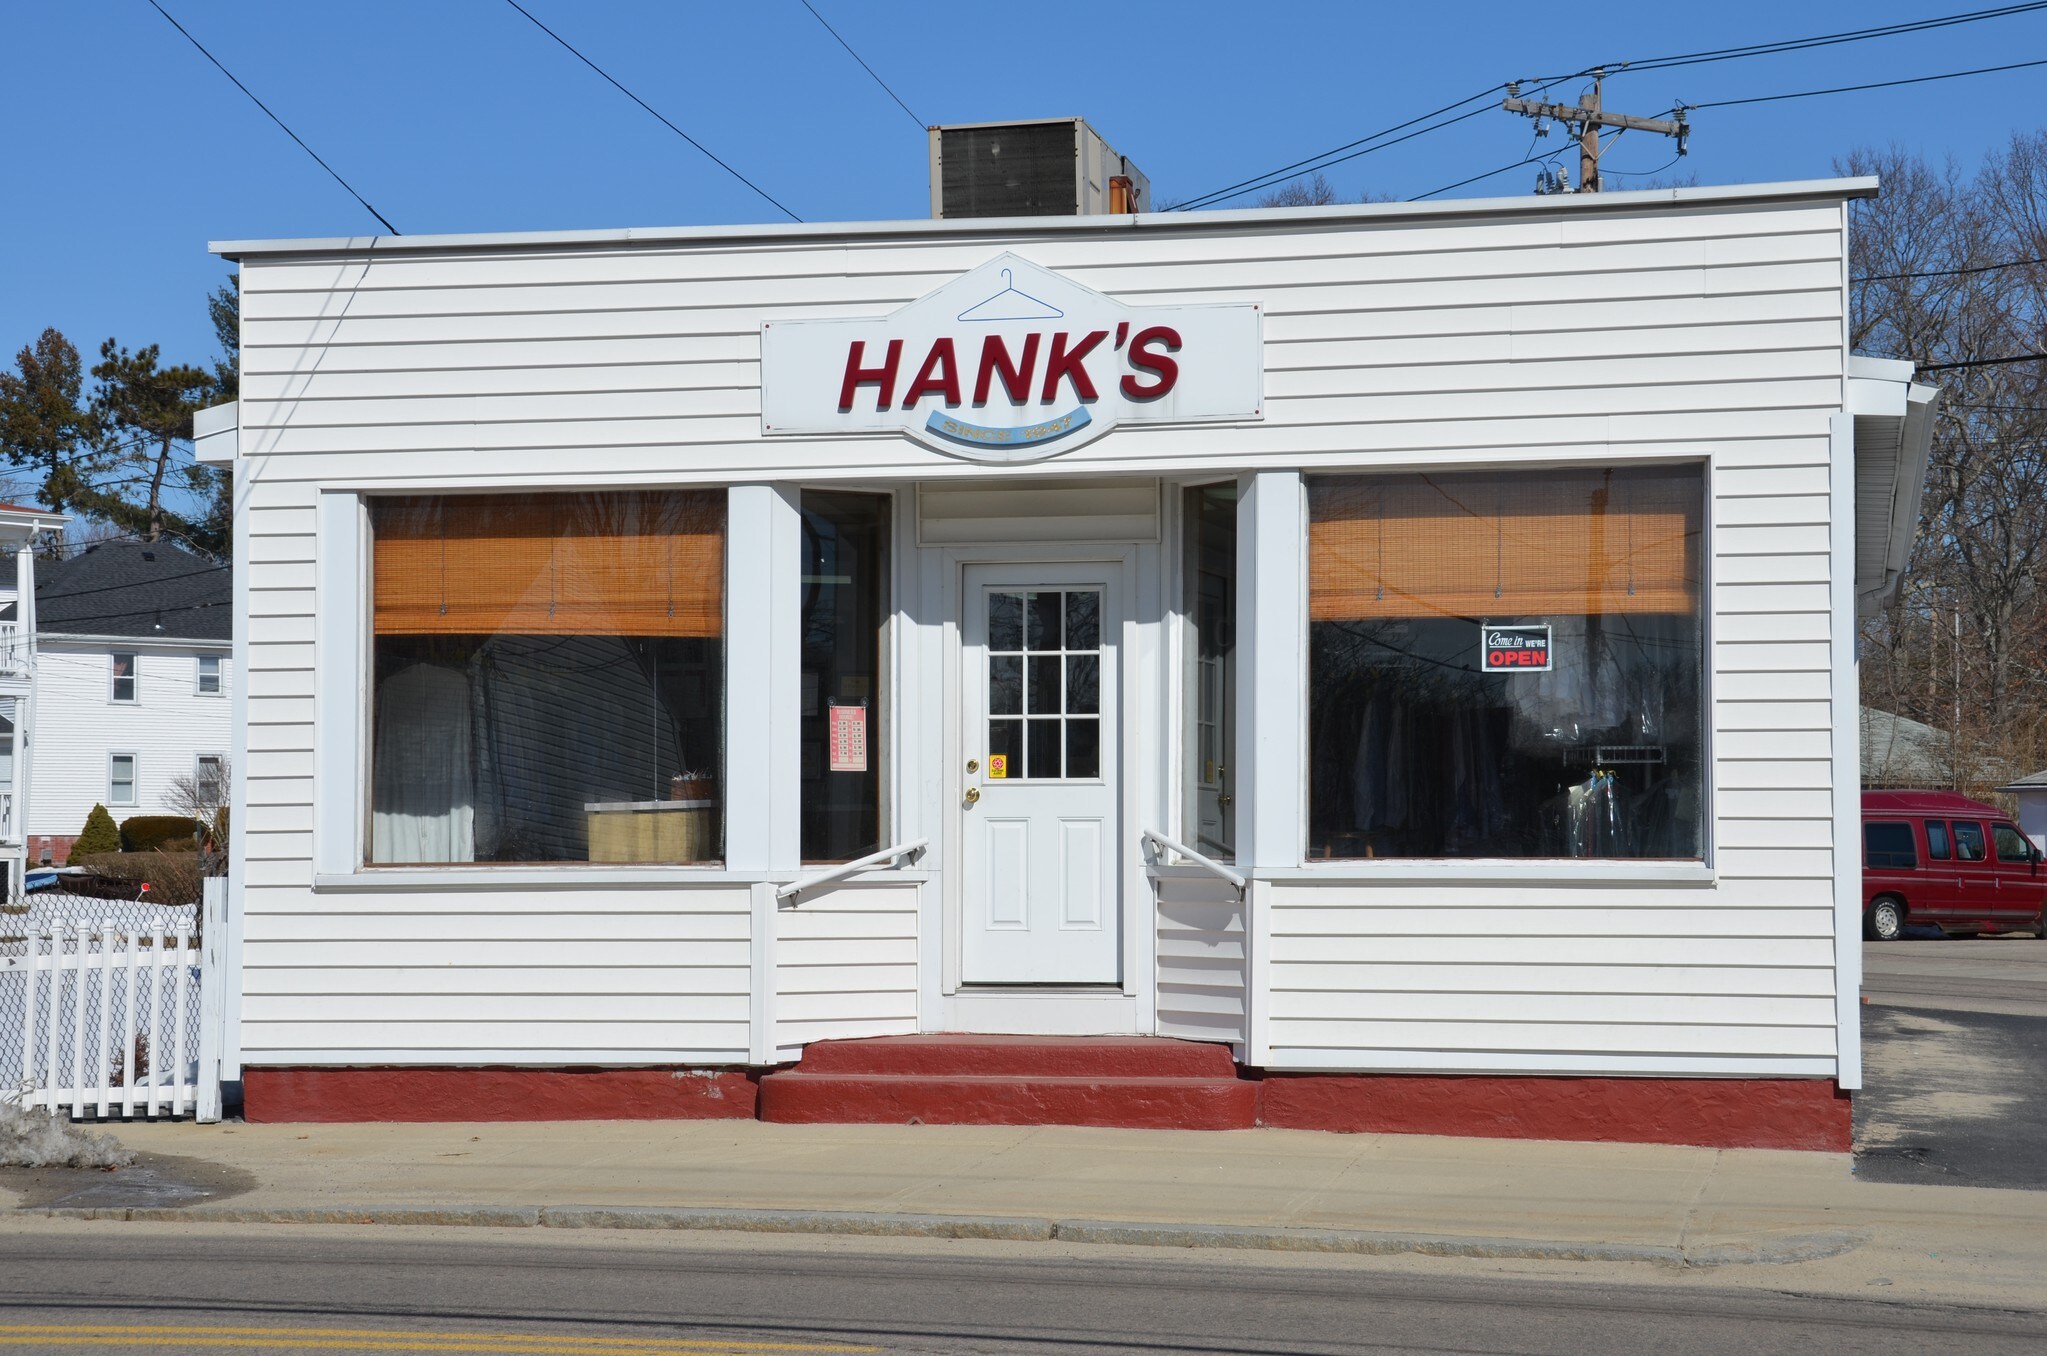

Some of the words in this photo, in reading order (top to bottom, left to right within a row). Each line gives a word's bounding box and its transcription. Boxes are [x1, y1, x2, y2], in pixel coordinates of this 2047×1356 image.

[838, 322, 1182, 411] HANK'S
[942, 420, 1012, 441] SINCE
[1489, 632, 1512, 646] Come
[1514, 636, 1523, 646] in
[1525, 640, 1546, 648] WE'RE
[1489, 651, 1546, 666] OPEN
